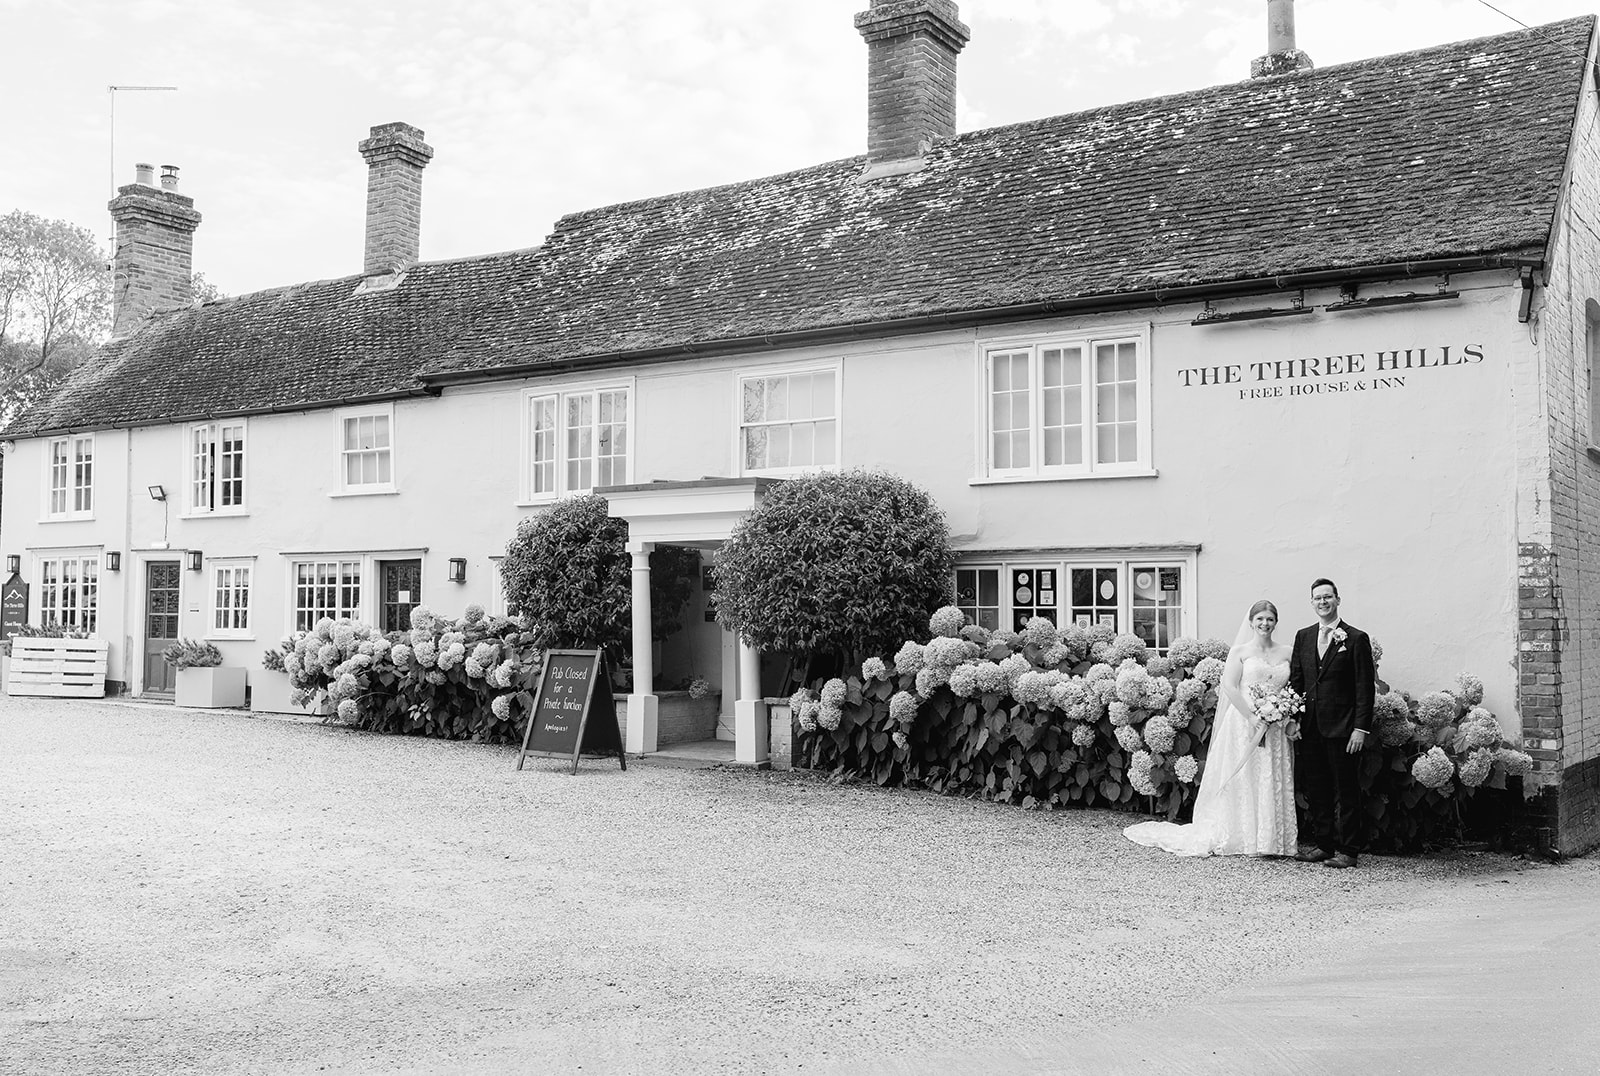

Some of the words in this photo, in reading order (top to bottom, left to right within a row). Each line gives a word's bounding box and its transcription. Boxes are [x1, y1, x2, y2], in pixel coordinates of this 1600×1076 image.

[1177, 364, 1242, 387] THE
[1250, 353, 1366, 381] THREE
[1376, 343, 1484, 371] HILLS
[1239, 386, 1283, 400] FREE
[1290, 381, 1350, 396] HOUSE
[1353, 380, 1366, 391] &
[1373, 376, 1406, 390] INN
[551, 666, 563, 679] Pub
[565, 666, 588, 679] Closed
[553, 682, 563, 693] for
[543, 697, 561, 709] Private
